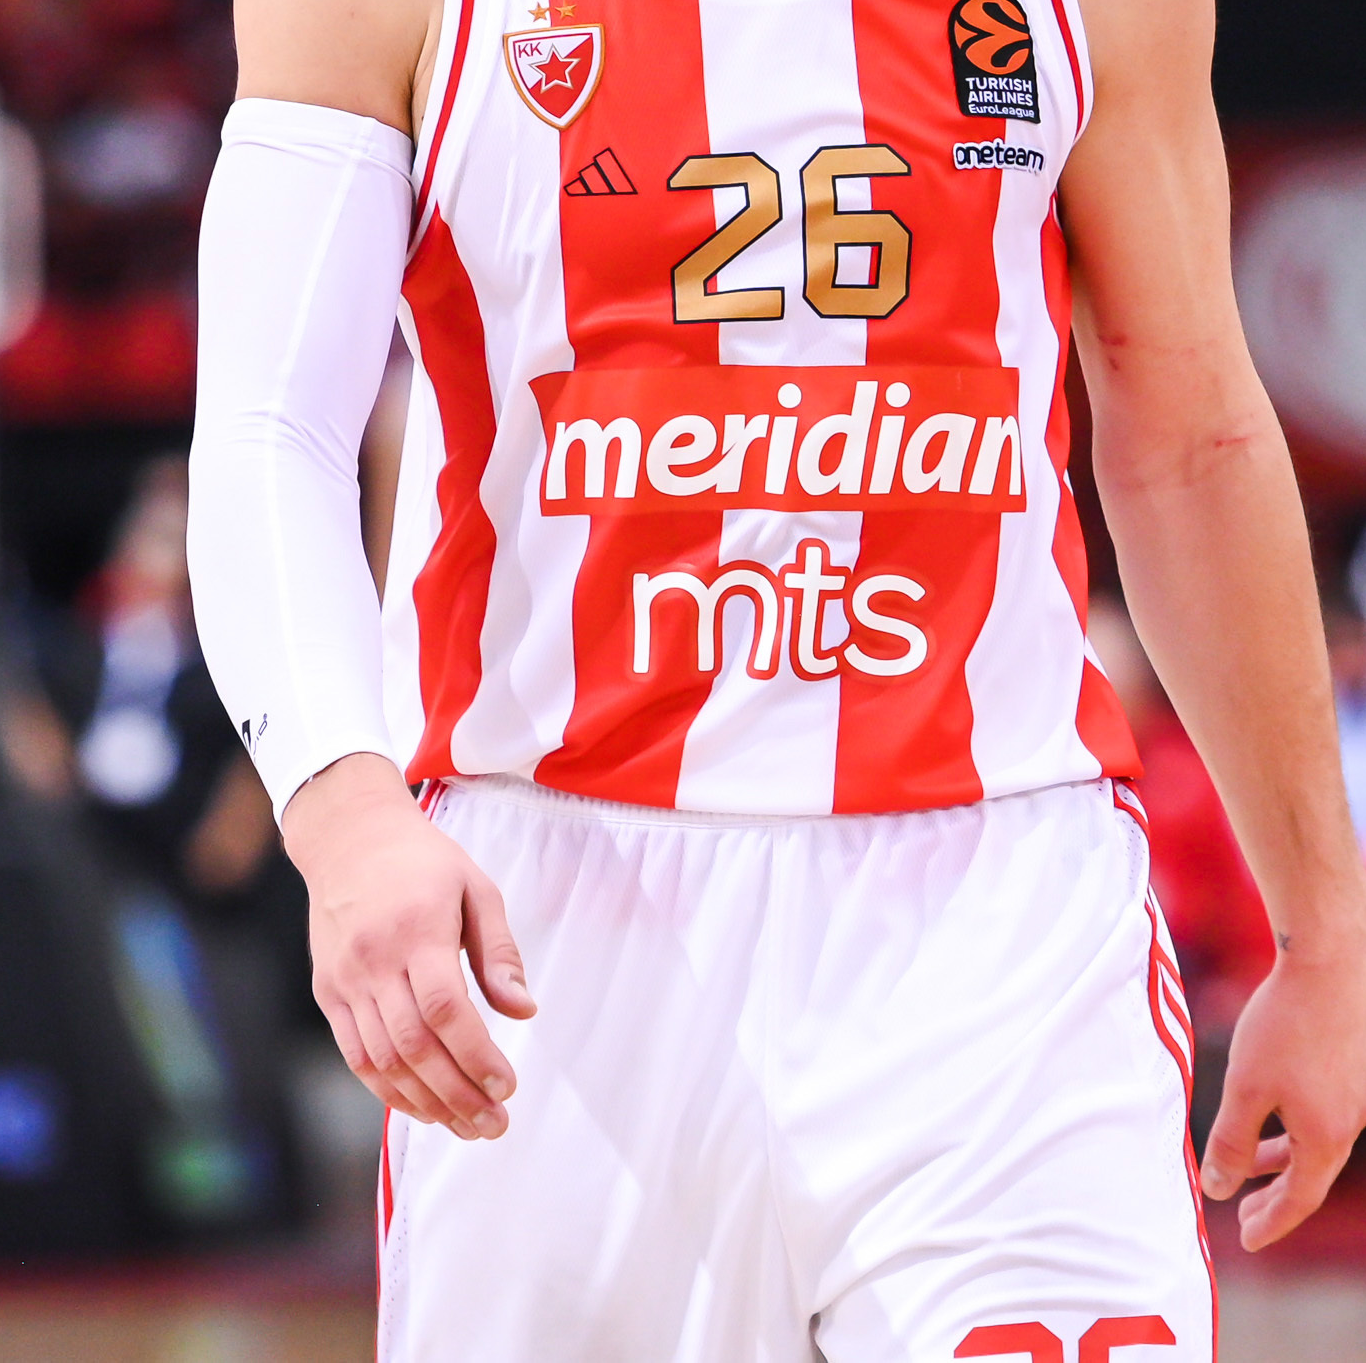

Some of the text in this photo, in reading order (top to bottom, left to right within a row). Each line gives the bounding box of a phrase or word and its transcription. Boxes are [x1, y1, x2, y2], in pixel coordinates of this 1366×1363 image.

[517, 41, 543, 58] KK
[965, 77, 1033, 93] TURKISH
[968, 90, 1034, 106] AIRLINES
[968, 104, 1035, 118] EuroLeague
[666, 144, 912, 324] 26
[544, 381, 1023, 500] meridian
[632, 545, 927, 677] mts
